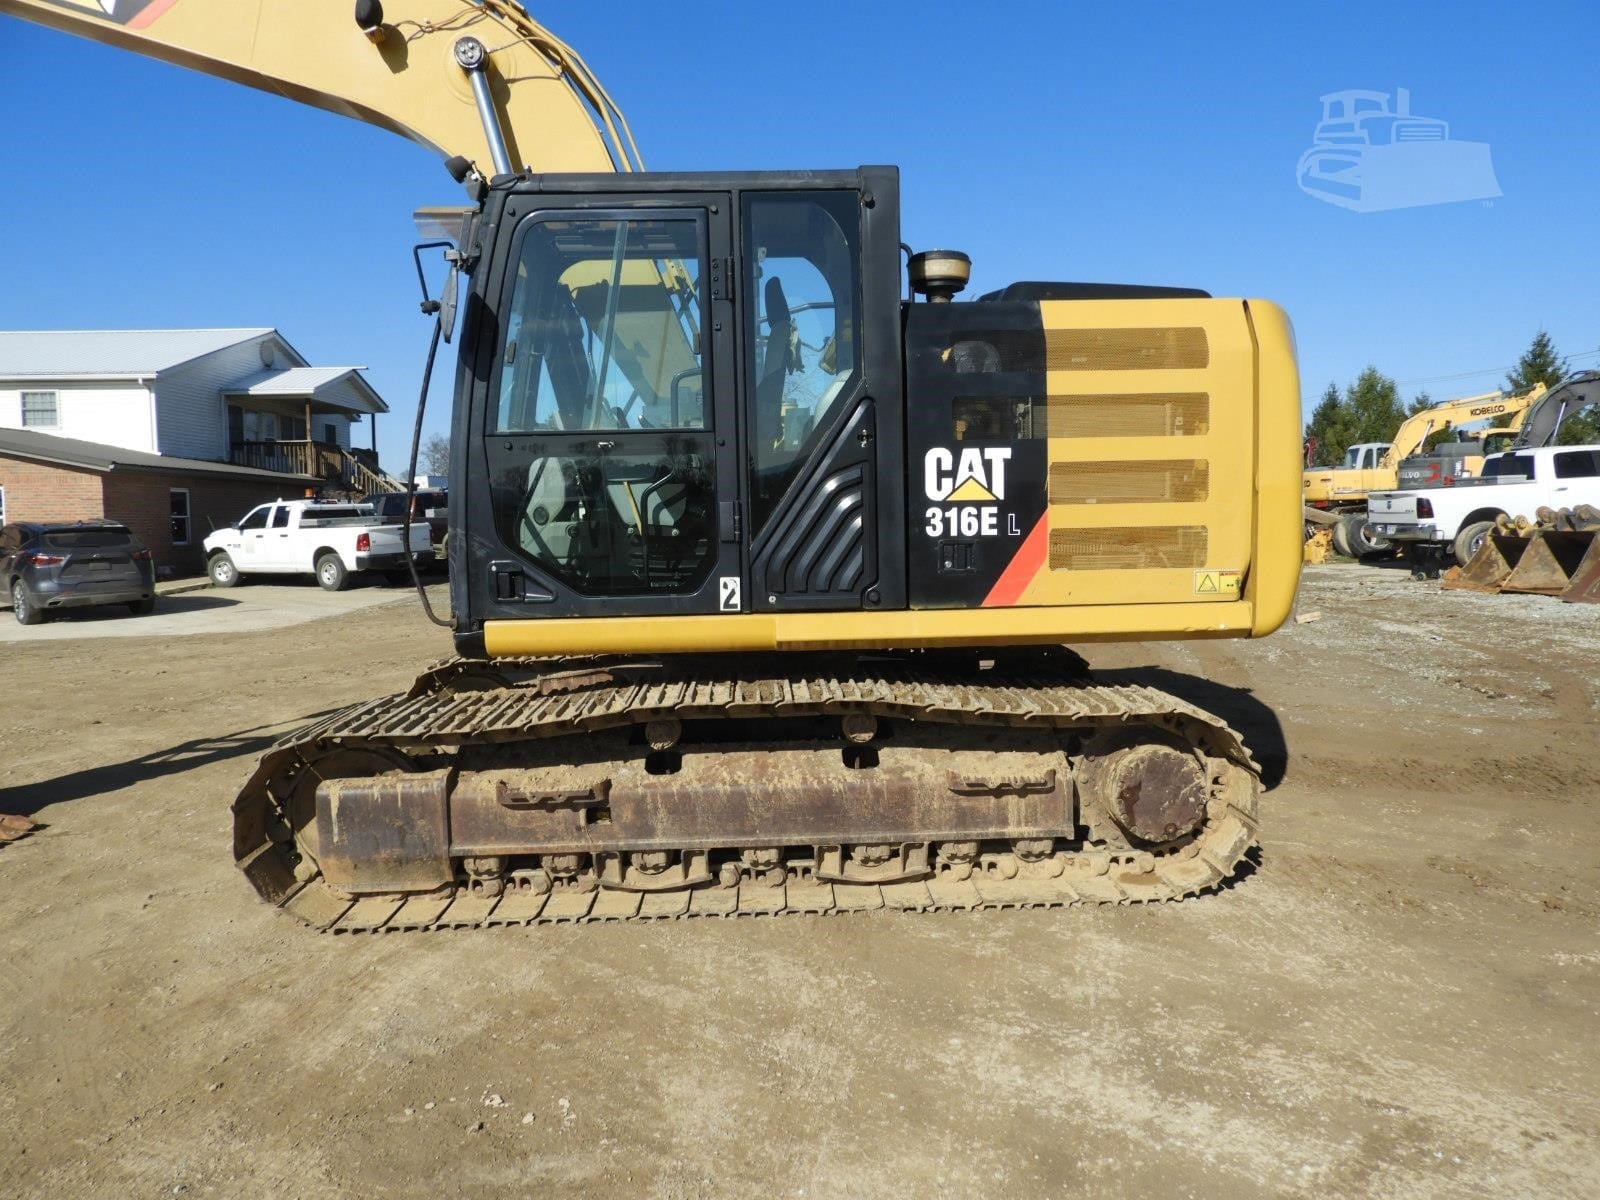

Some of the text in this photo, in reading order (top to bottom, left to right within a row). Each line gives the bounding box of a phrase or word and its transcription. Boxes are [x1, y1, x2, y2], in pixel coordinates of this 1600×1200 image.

[1470, 404, 1505, 416] KOBELCO
[924, 447, 1012, 501] CAT
[1399, 471, 1420, 479] OLVO
[925, 506, 1021, 537] 316E L
[722, 579, 739, 610] 2
